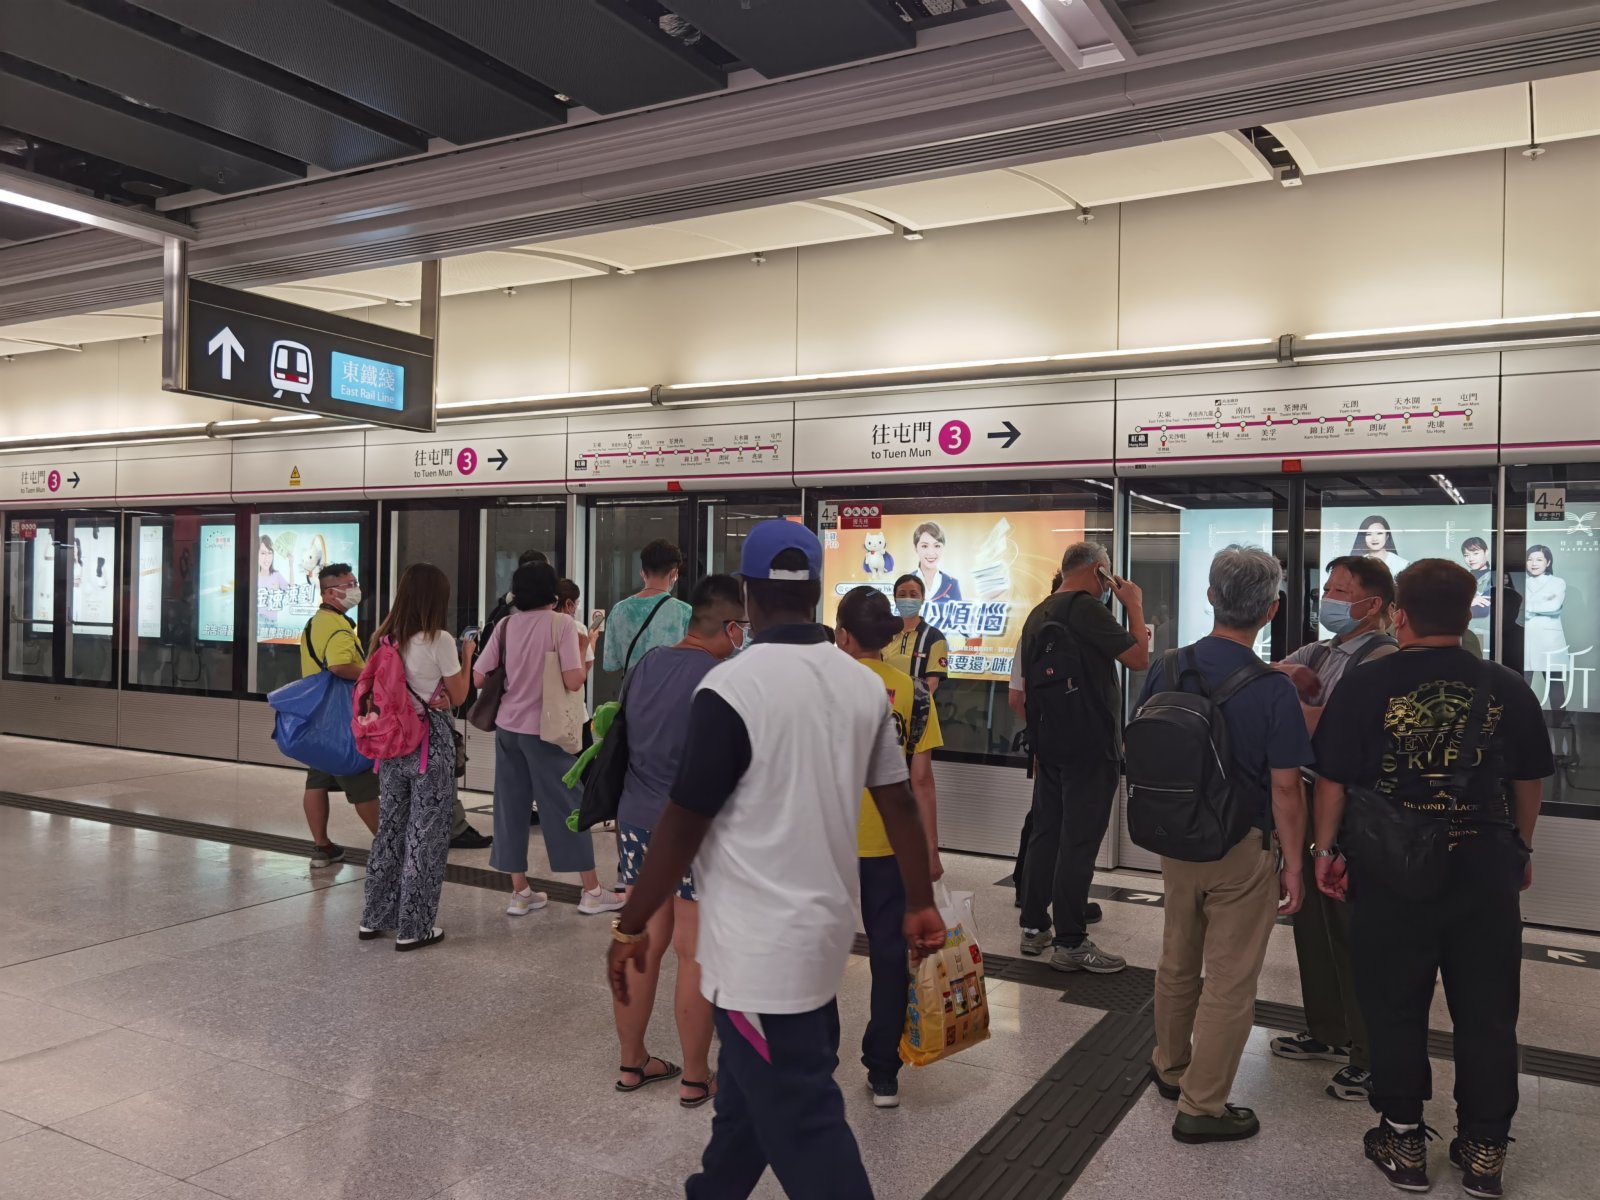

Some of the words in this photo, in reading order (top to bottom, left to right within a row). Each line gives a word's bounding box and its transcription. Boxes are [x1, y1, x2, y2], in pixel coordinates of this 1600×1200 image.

[342, 360, 396, 392] 東鐵綫
[340, 384, 359, 397] East
[360, 388, 376, 401] Rail
[377, 391, 395, 404] Line
[1460, 392, 1478, 402] 屯門
[1342, 400, 1359, 409] 元朗
[872, 421, 932, 446] 往屯門
[948, 425, 962, 450] 3
[415, 448, 453, 467] 往屯門
[462, 452, 472, 471] 3
[871, 450, 881, 460] to
[883, 449, 907, 459] Tuen
[909, 447, 932, 458] Mun
[21, 470, 46, 485] 往屯門
[51, 473, 58, 489] 3
[414, 470, 421, 478] to
[422, 470, 437, 478] Tuen
[438, 469, 453, 477] Mun
[1535, 492, 1564, 510] 4-4
[821, 508, 838, 522] 4-5
[1539, 644, 1596, 709] 所
